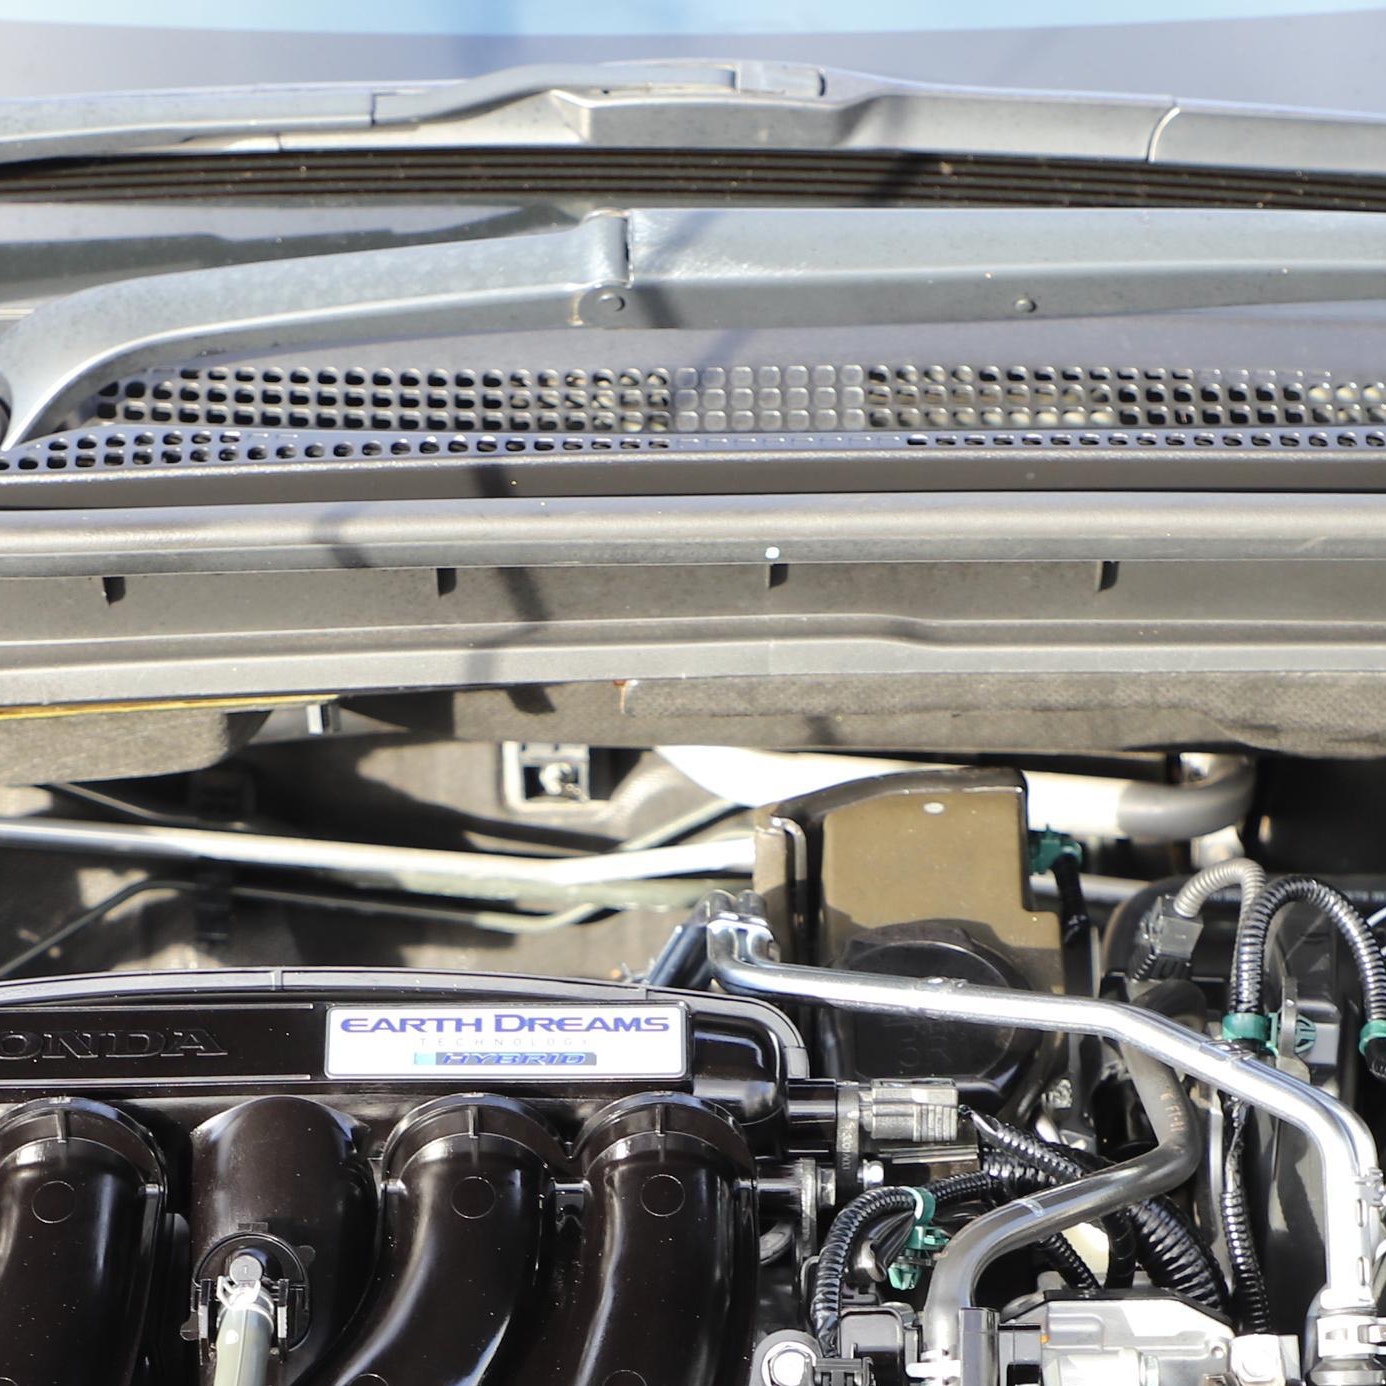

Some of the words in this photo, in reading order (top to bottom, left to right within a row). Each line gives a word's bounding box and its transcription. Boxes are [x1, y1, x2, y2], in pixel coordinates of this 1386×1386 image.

[340, 1017, 483, 1033] EARTH
[494, 1013, 670, 1033] DREAMS
[419, 1037, 589, 1047] TECHNOLOGY
[443, 1052, 587, 1065] HYBRID
